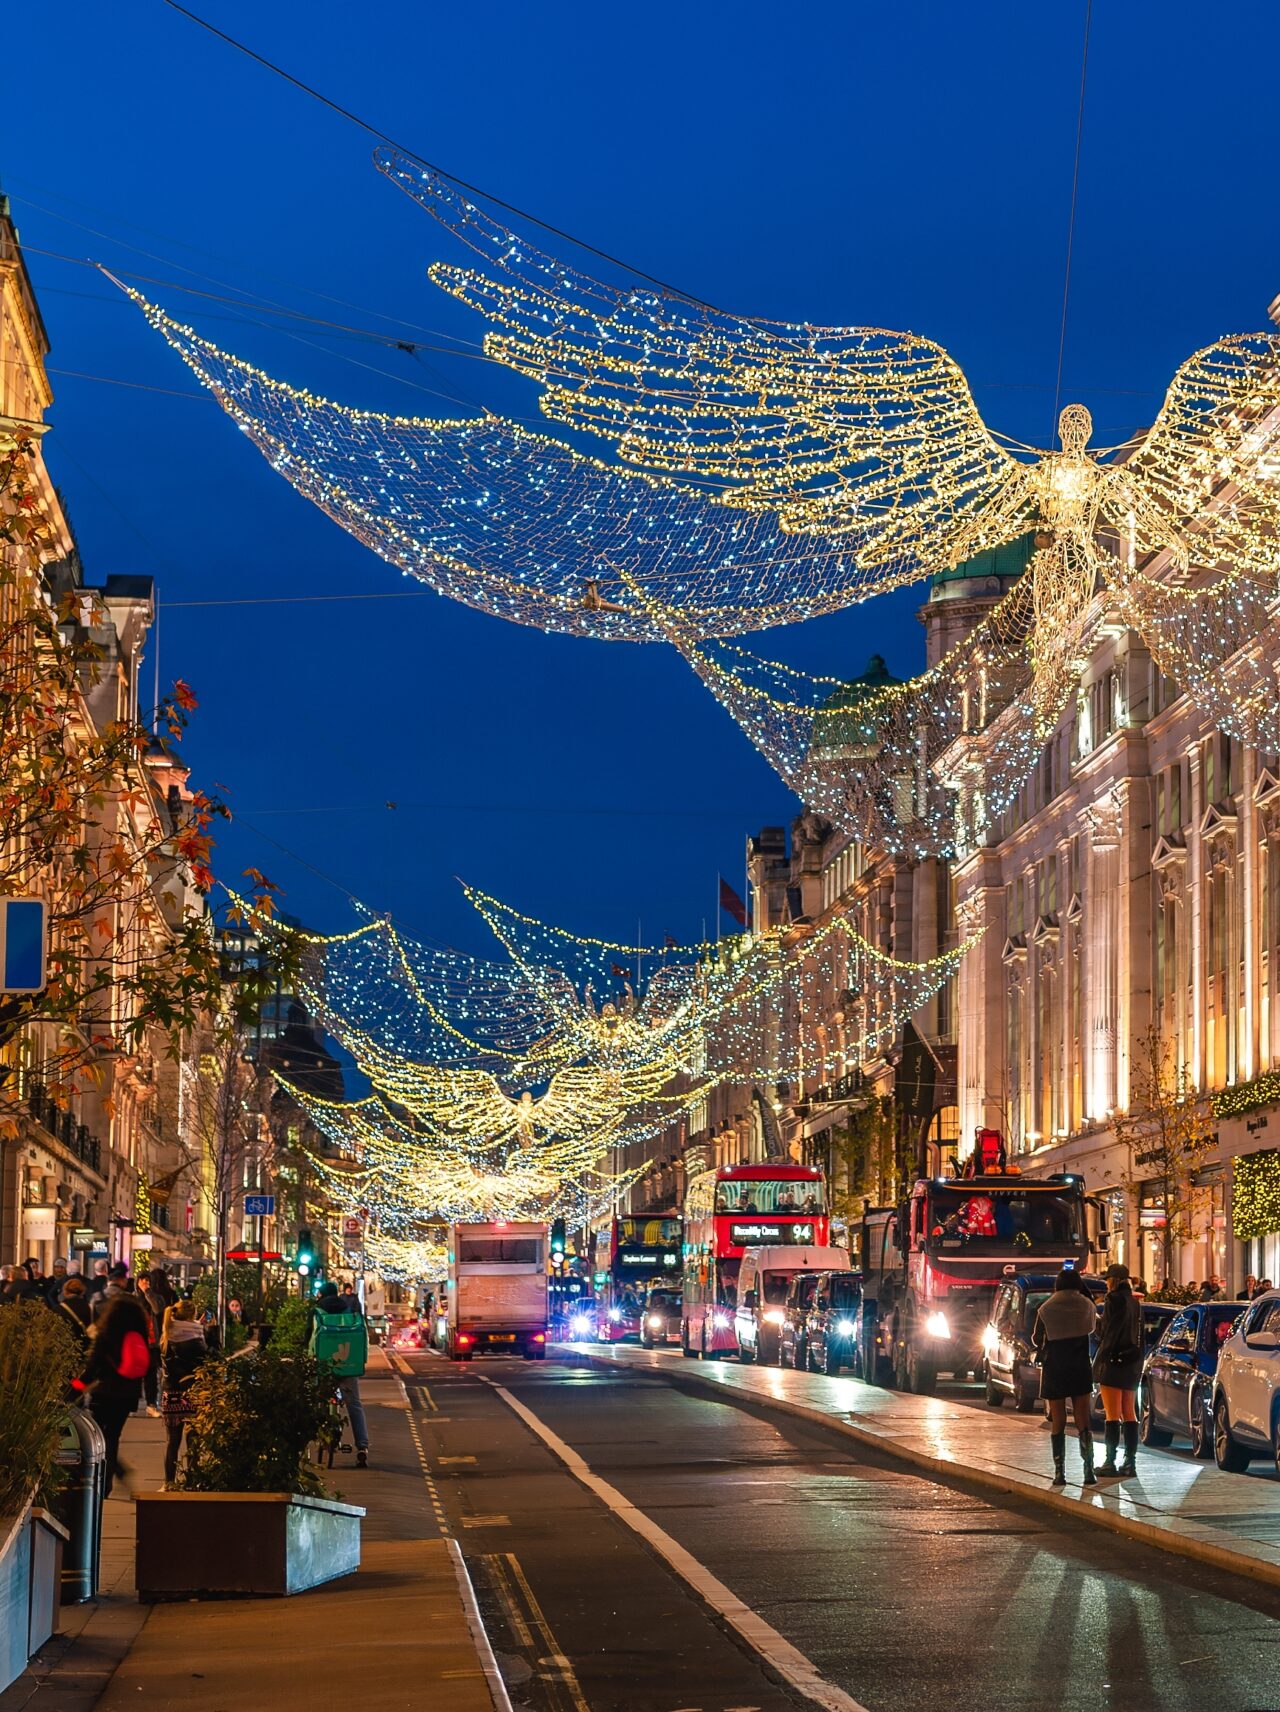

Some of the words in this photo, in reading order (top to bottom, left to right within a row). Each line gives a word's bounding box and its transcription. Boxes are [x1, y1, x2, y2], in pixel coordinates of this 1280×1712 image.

[766, 1126, 776, 1157] Calvin
[792, 1224, 811, 1239] 94
[663, 1254, 676, 1265] 88
